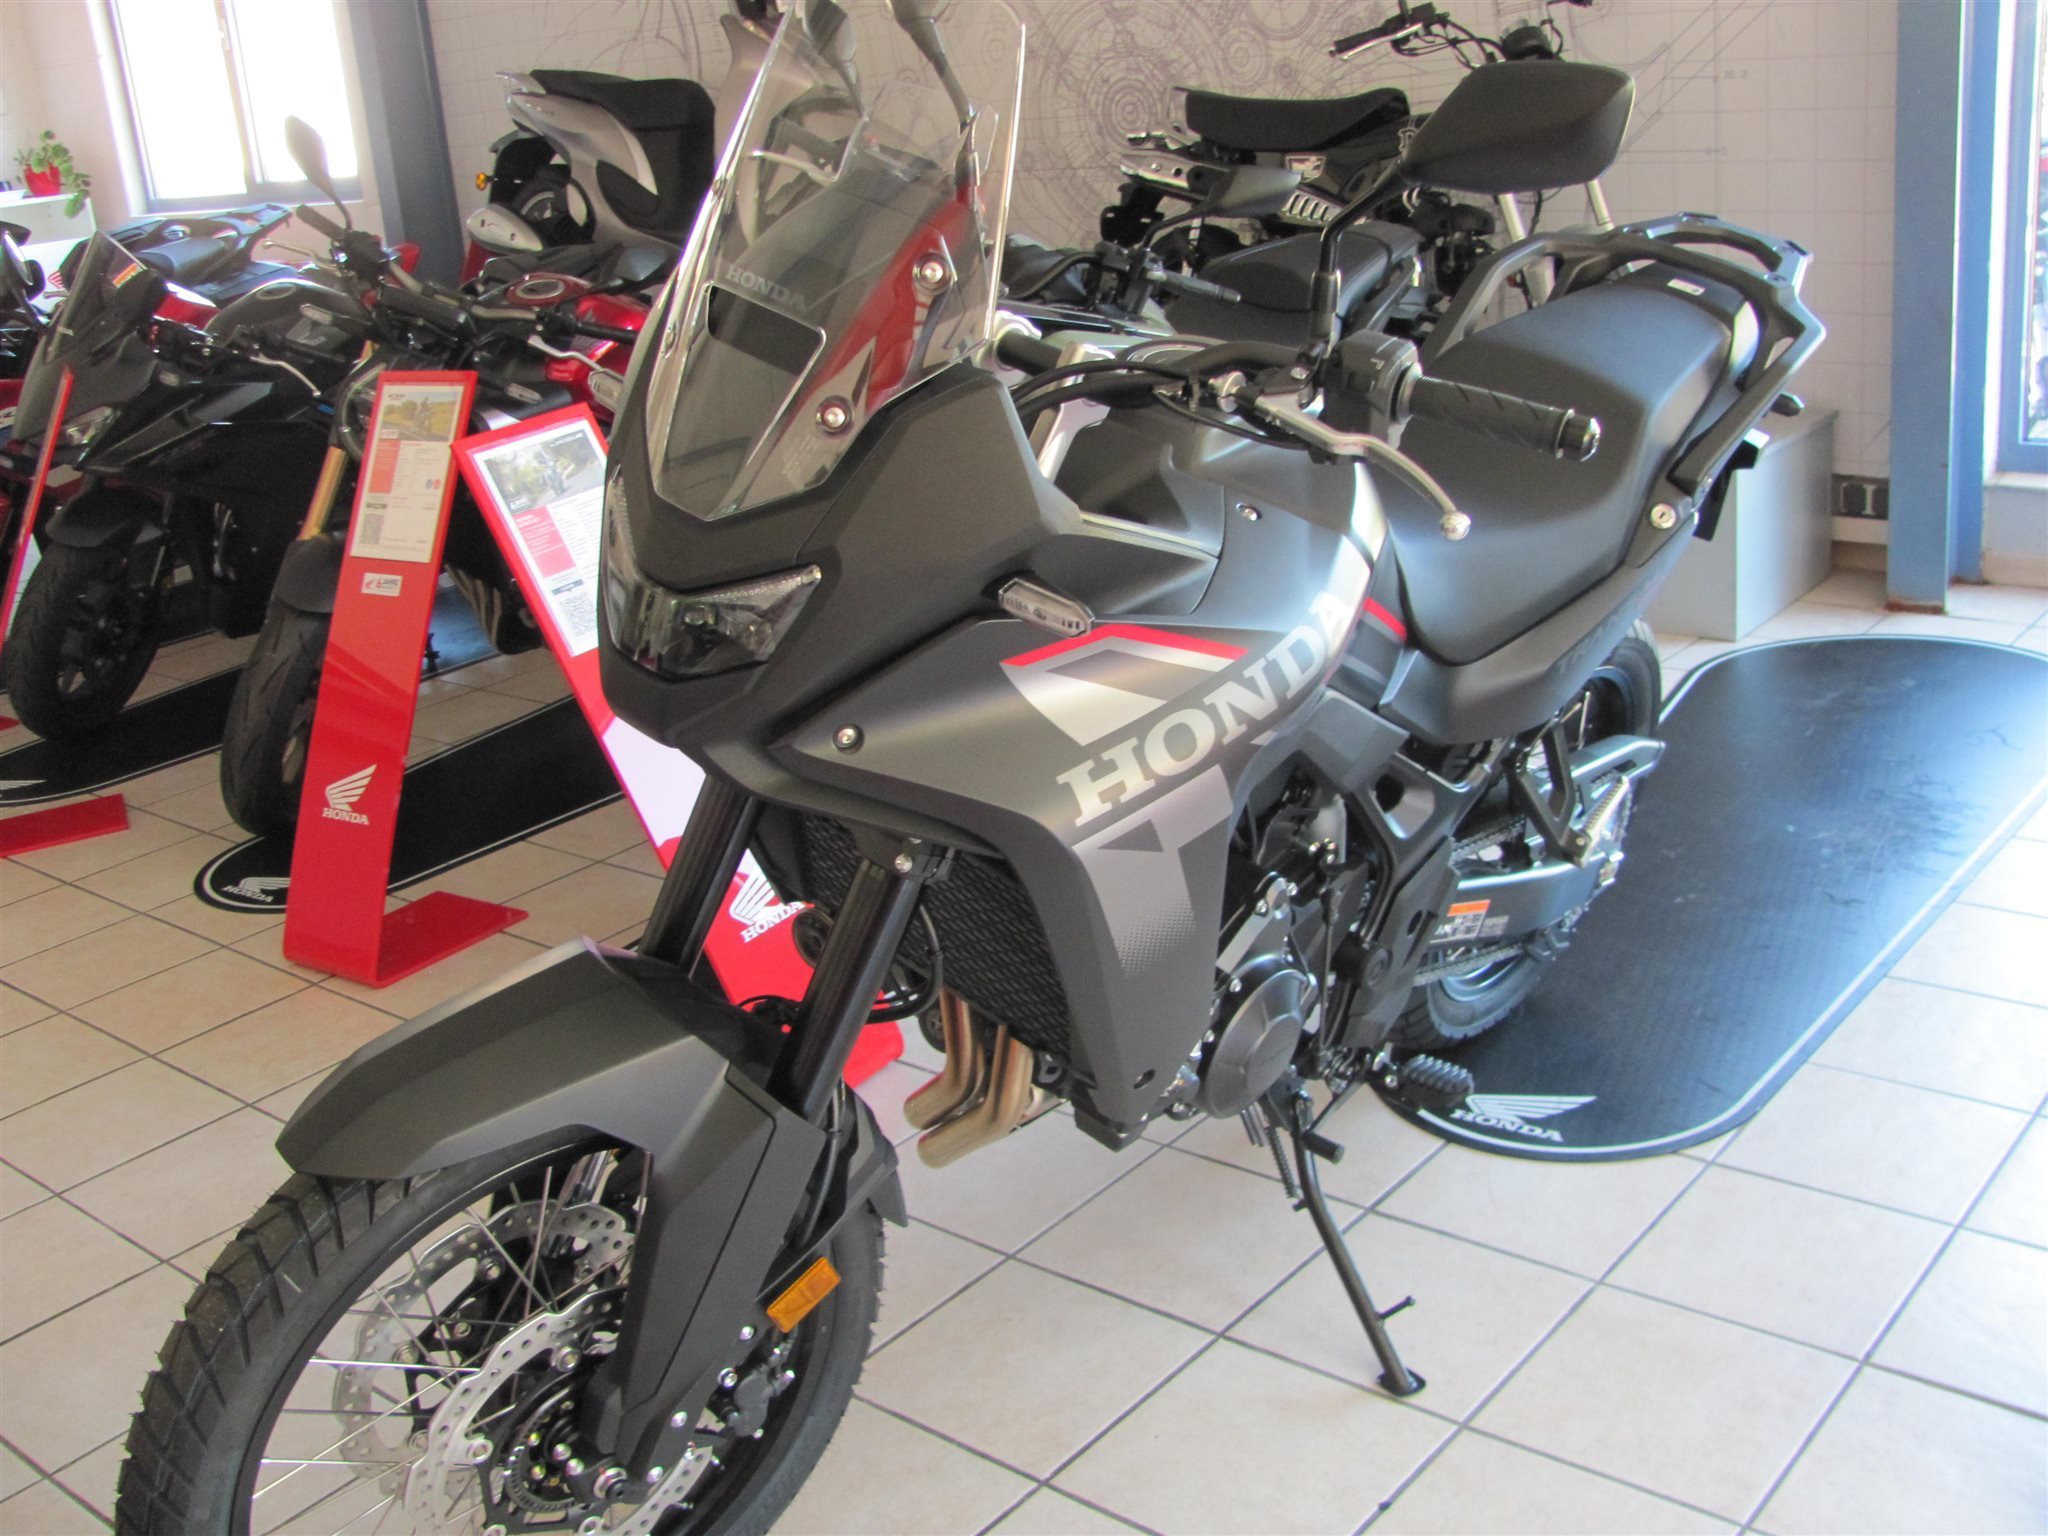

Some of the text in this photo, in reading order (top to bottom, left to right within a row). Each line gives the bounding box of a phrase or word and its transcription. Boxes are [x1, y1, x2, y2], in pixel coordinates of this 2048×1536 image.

[725, 264, 807, 311] HONDA
[1056, 591, 1352, 828] HONDA
[322, 807, 370, 826] HONDA
[221, 885, 274, 903] HONDA
[740, 901, 806, 944] HONDA
[1449, 1108, 1565, 1143] HONDA
